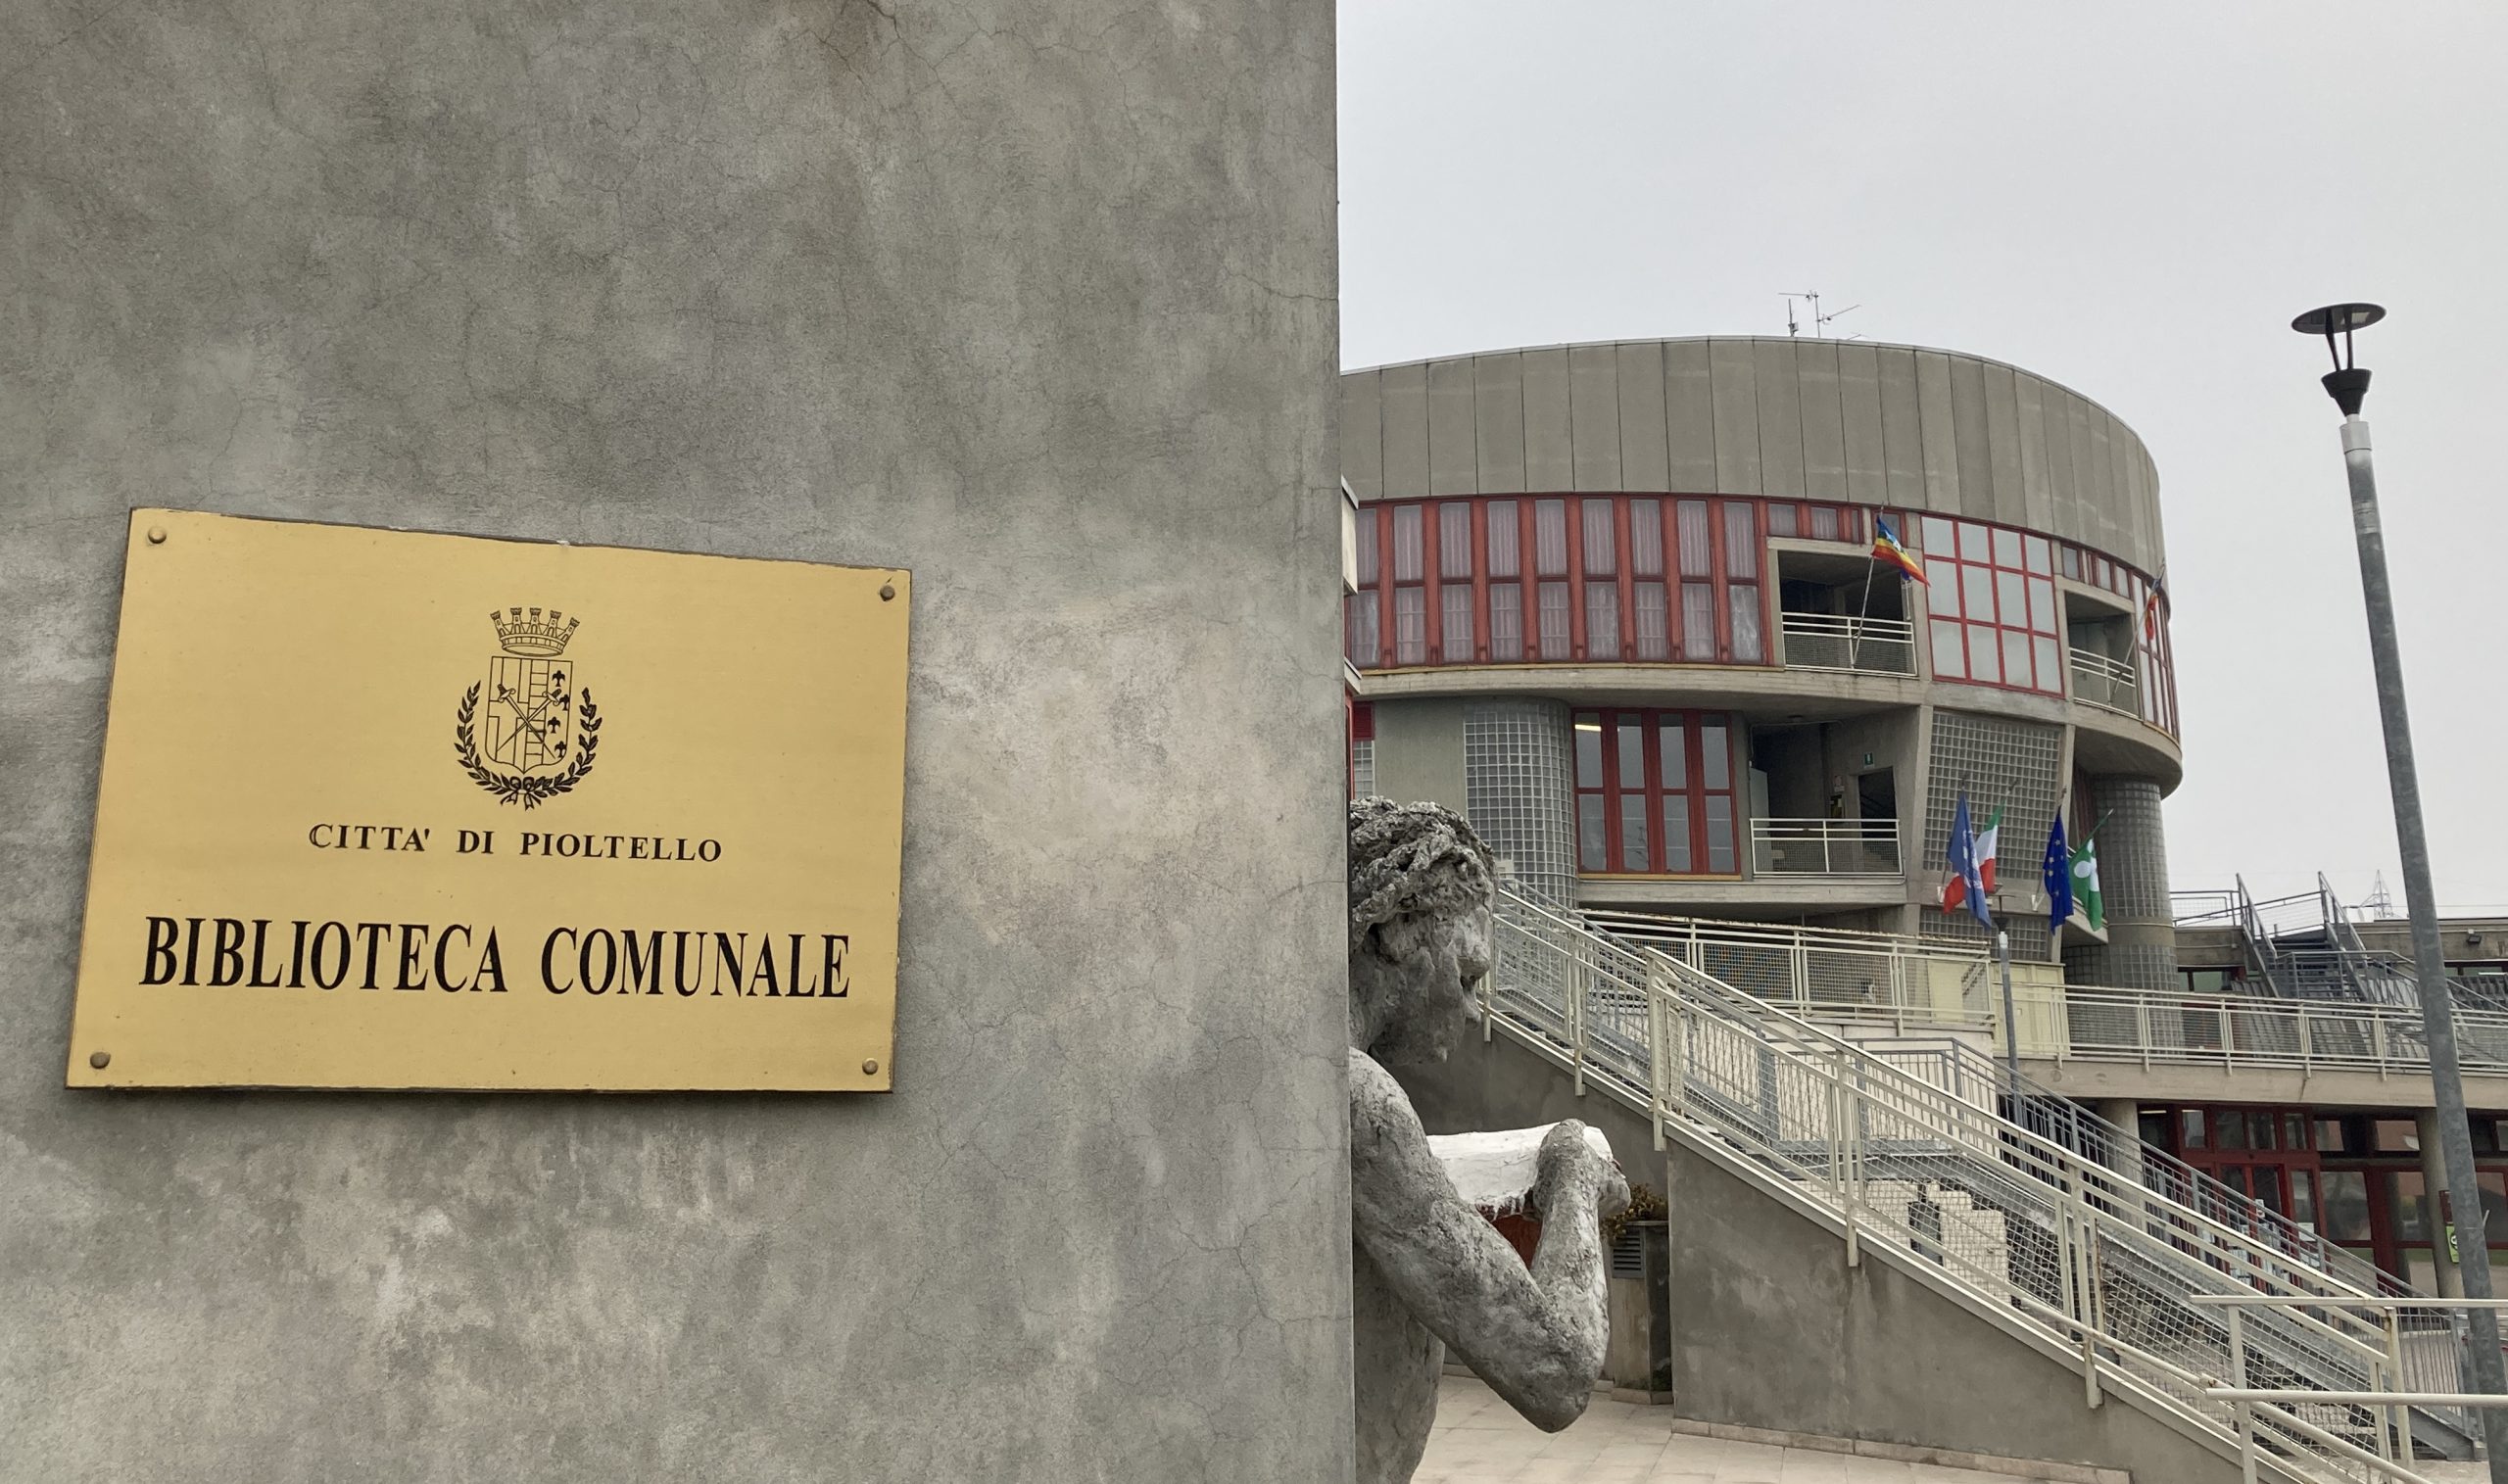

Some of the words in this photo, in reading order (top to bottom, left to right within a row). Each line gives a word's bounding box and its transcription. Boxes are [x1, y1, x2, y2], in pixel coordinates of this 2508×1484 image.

[310, 824, 431, 852] CITTA'
[458, 830, 495, 855] DI
[520, 832, 723, 862] PIOLTELLO
[139, 916, 508, 993] BIBLIOTECA
[541, 927, 850, 998] COMUNALE
